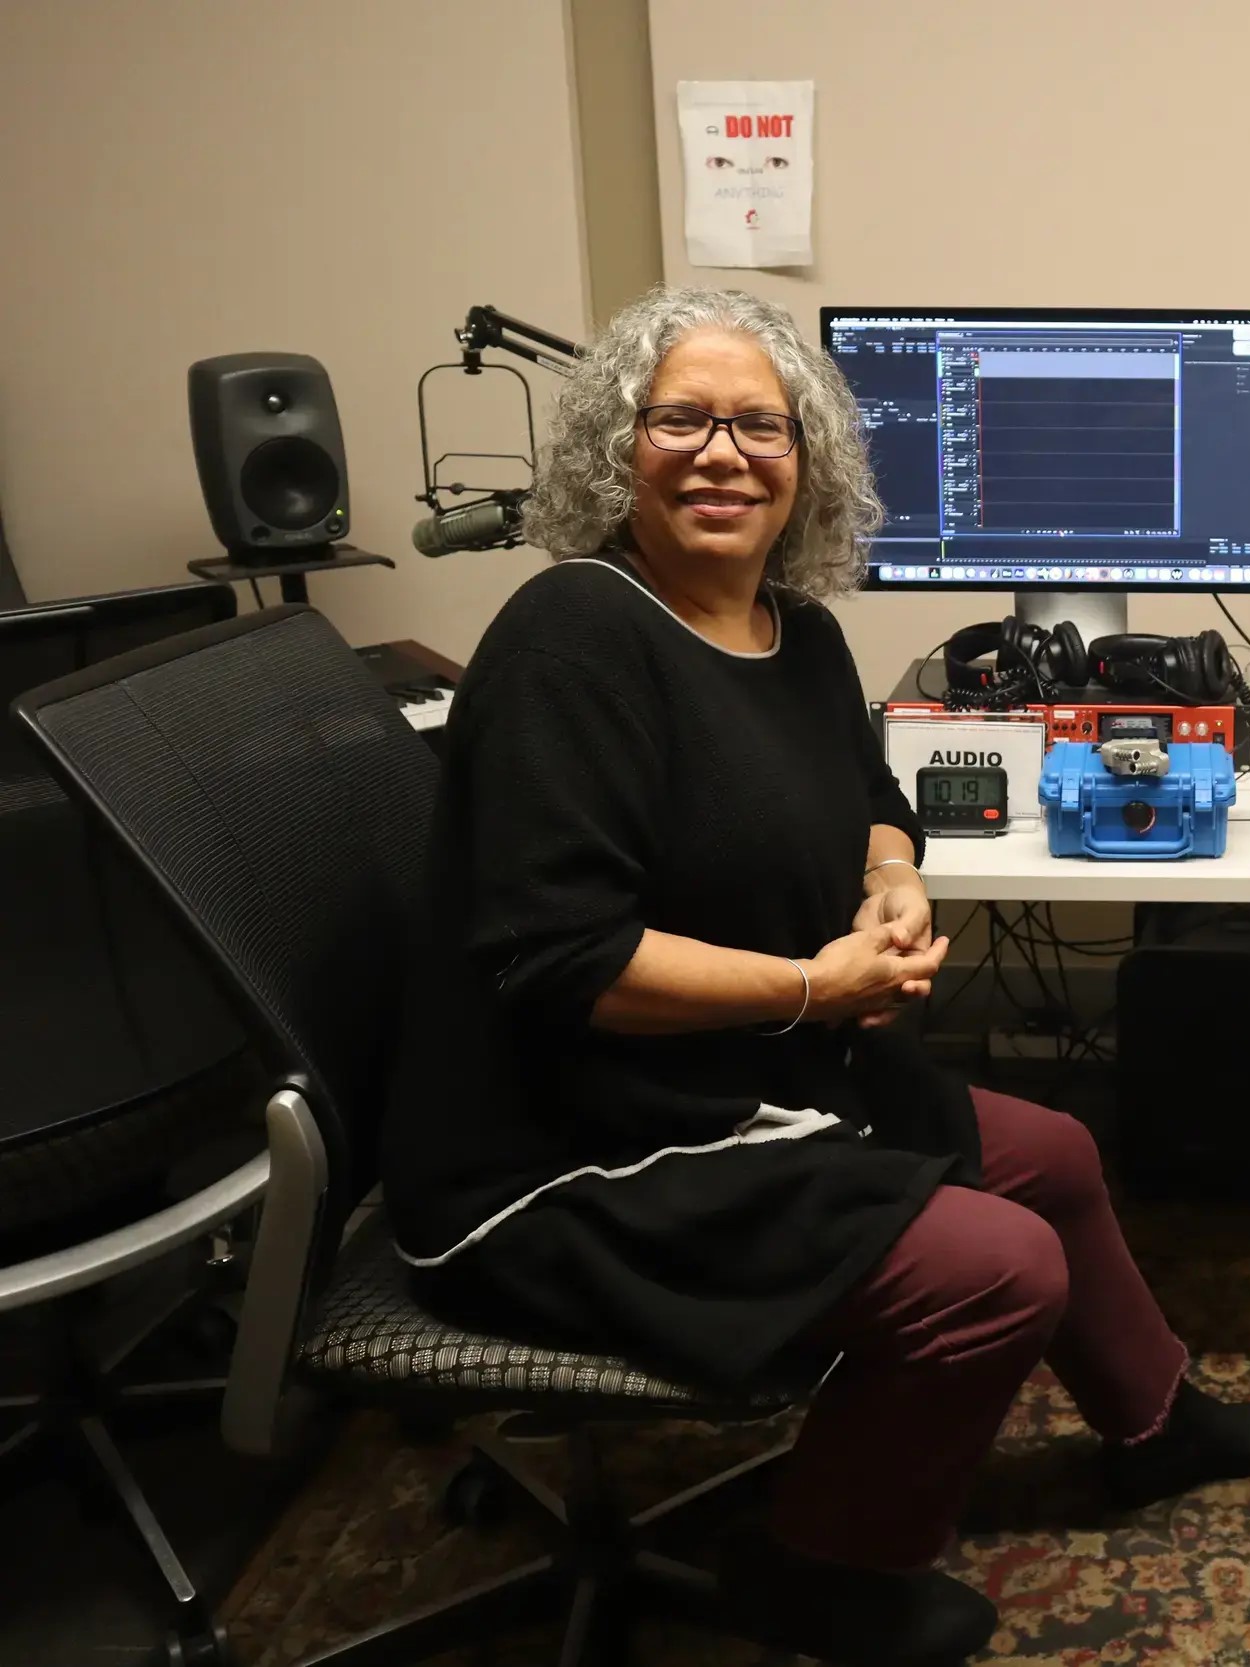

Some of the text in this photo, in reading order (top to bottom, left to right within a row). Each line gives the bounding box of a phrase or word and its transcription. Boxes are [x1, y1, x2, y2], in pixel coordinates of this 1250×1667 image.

[725, 115, 752, 138] DO
[757, 115, 794, 138] NOT
[929, 750, 1003, 767] AUDIO
